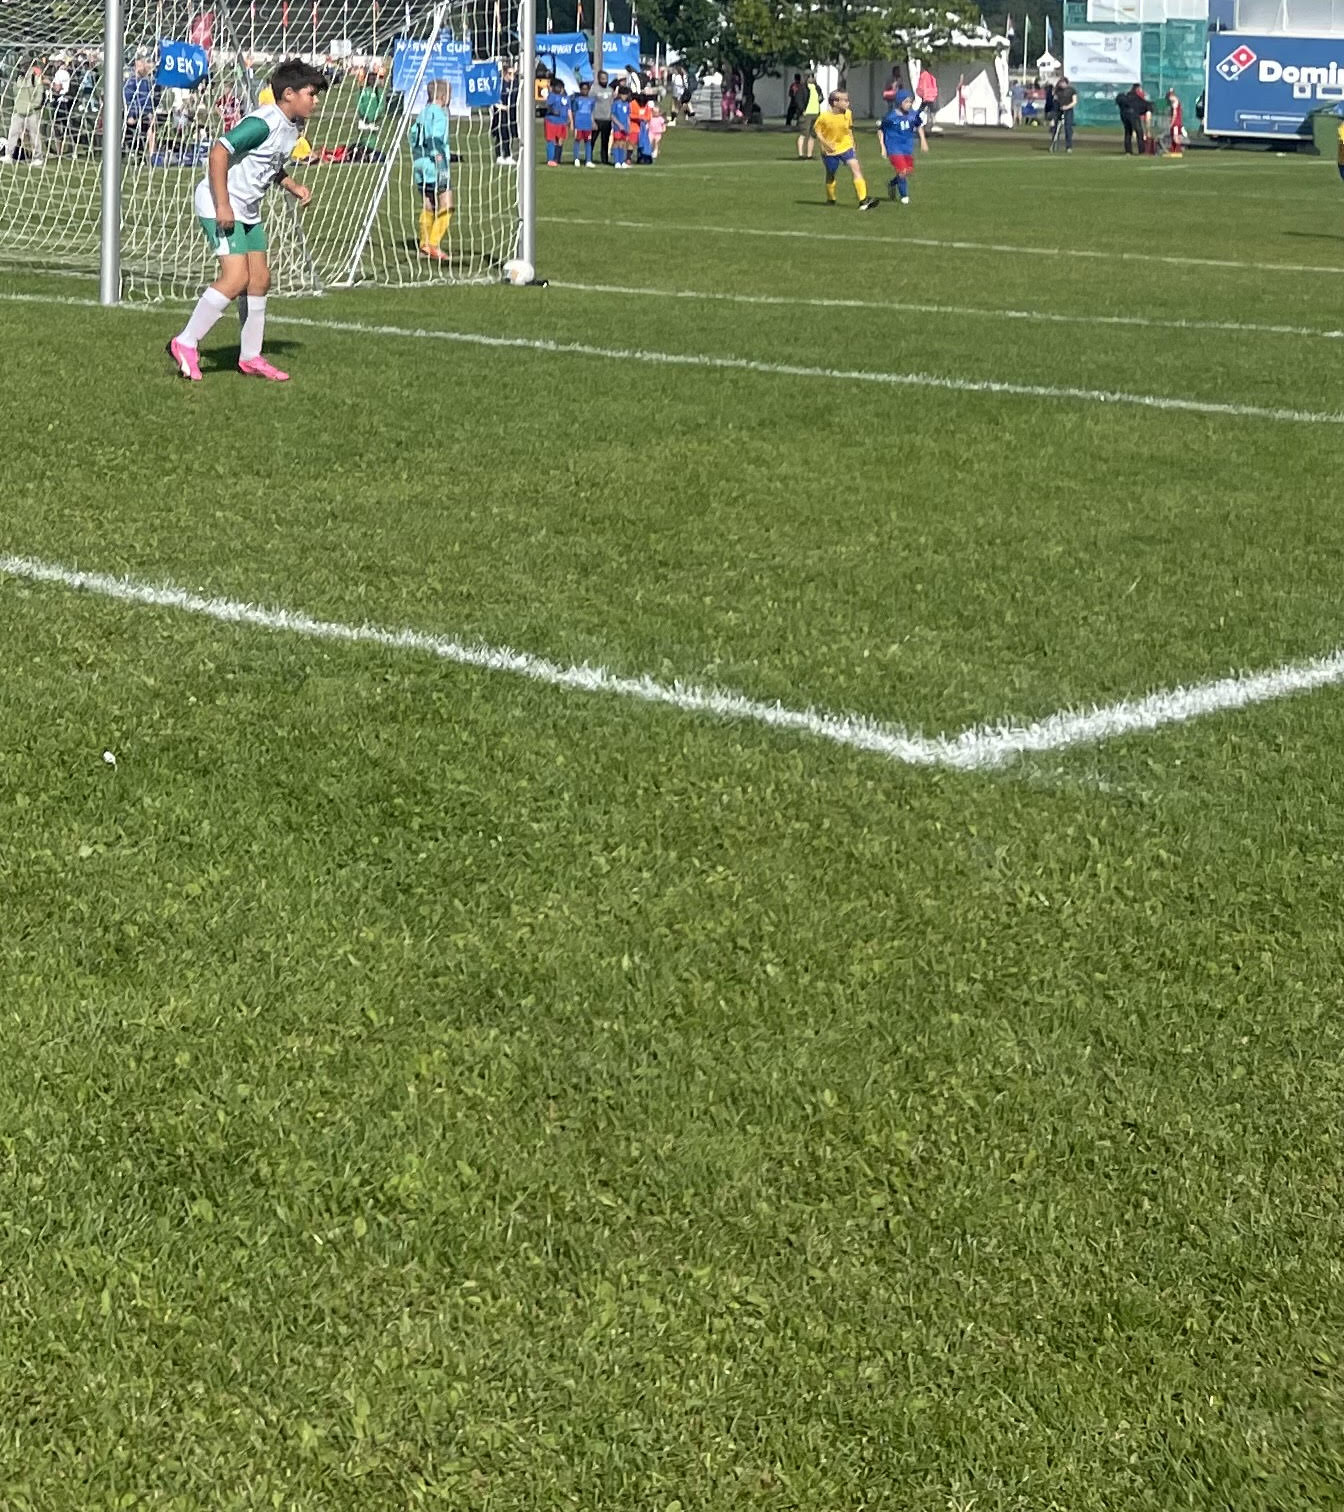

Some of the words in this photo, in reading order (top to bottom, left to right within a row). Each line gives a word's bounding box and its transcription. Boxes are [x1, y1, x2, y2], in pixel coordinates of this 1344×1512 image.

[446, 42, 471, 53] CUP
[575, 43, 588, 54] CU
[164, 55, 175, 71] 9
[177, 56, 194, 75] EK
[195, 60, 204, 76] 7
[468, 78, 476, 93] 8
[477, 77, 491, 93] EK
[491, 76, 498, 90] 7
